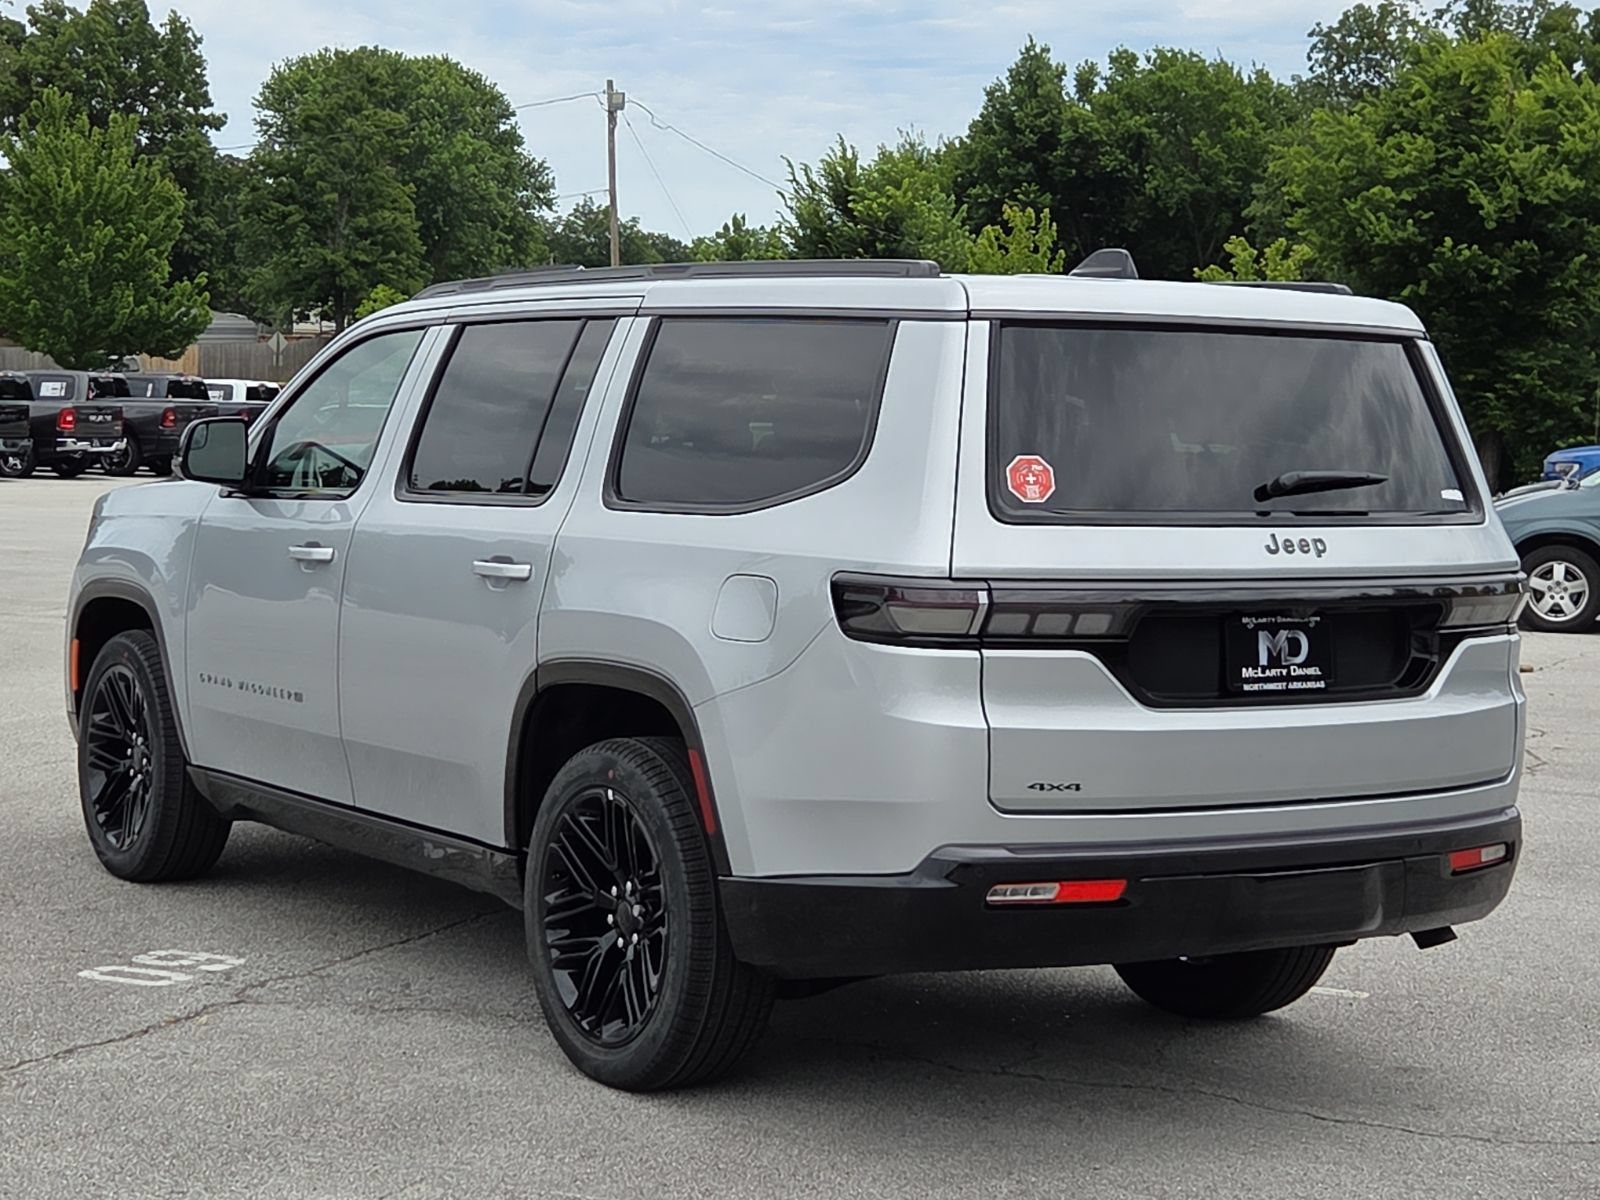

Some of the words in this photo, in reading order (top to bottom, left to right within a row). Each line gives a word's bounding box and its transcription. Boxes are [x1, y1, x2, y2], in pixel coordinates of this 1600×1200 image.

[88, 414, 112, 422] RAM
[1264, 533, 1327, 558] Jeep
[1258, 630, 1309, 666] MD
